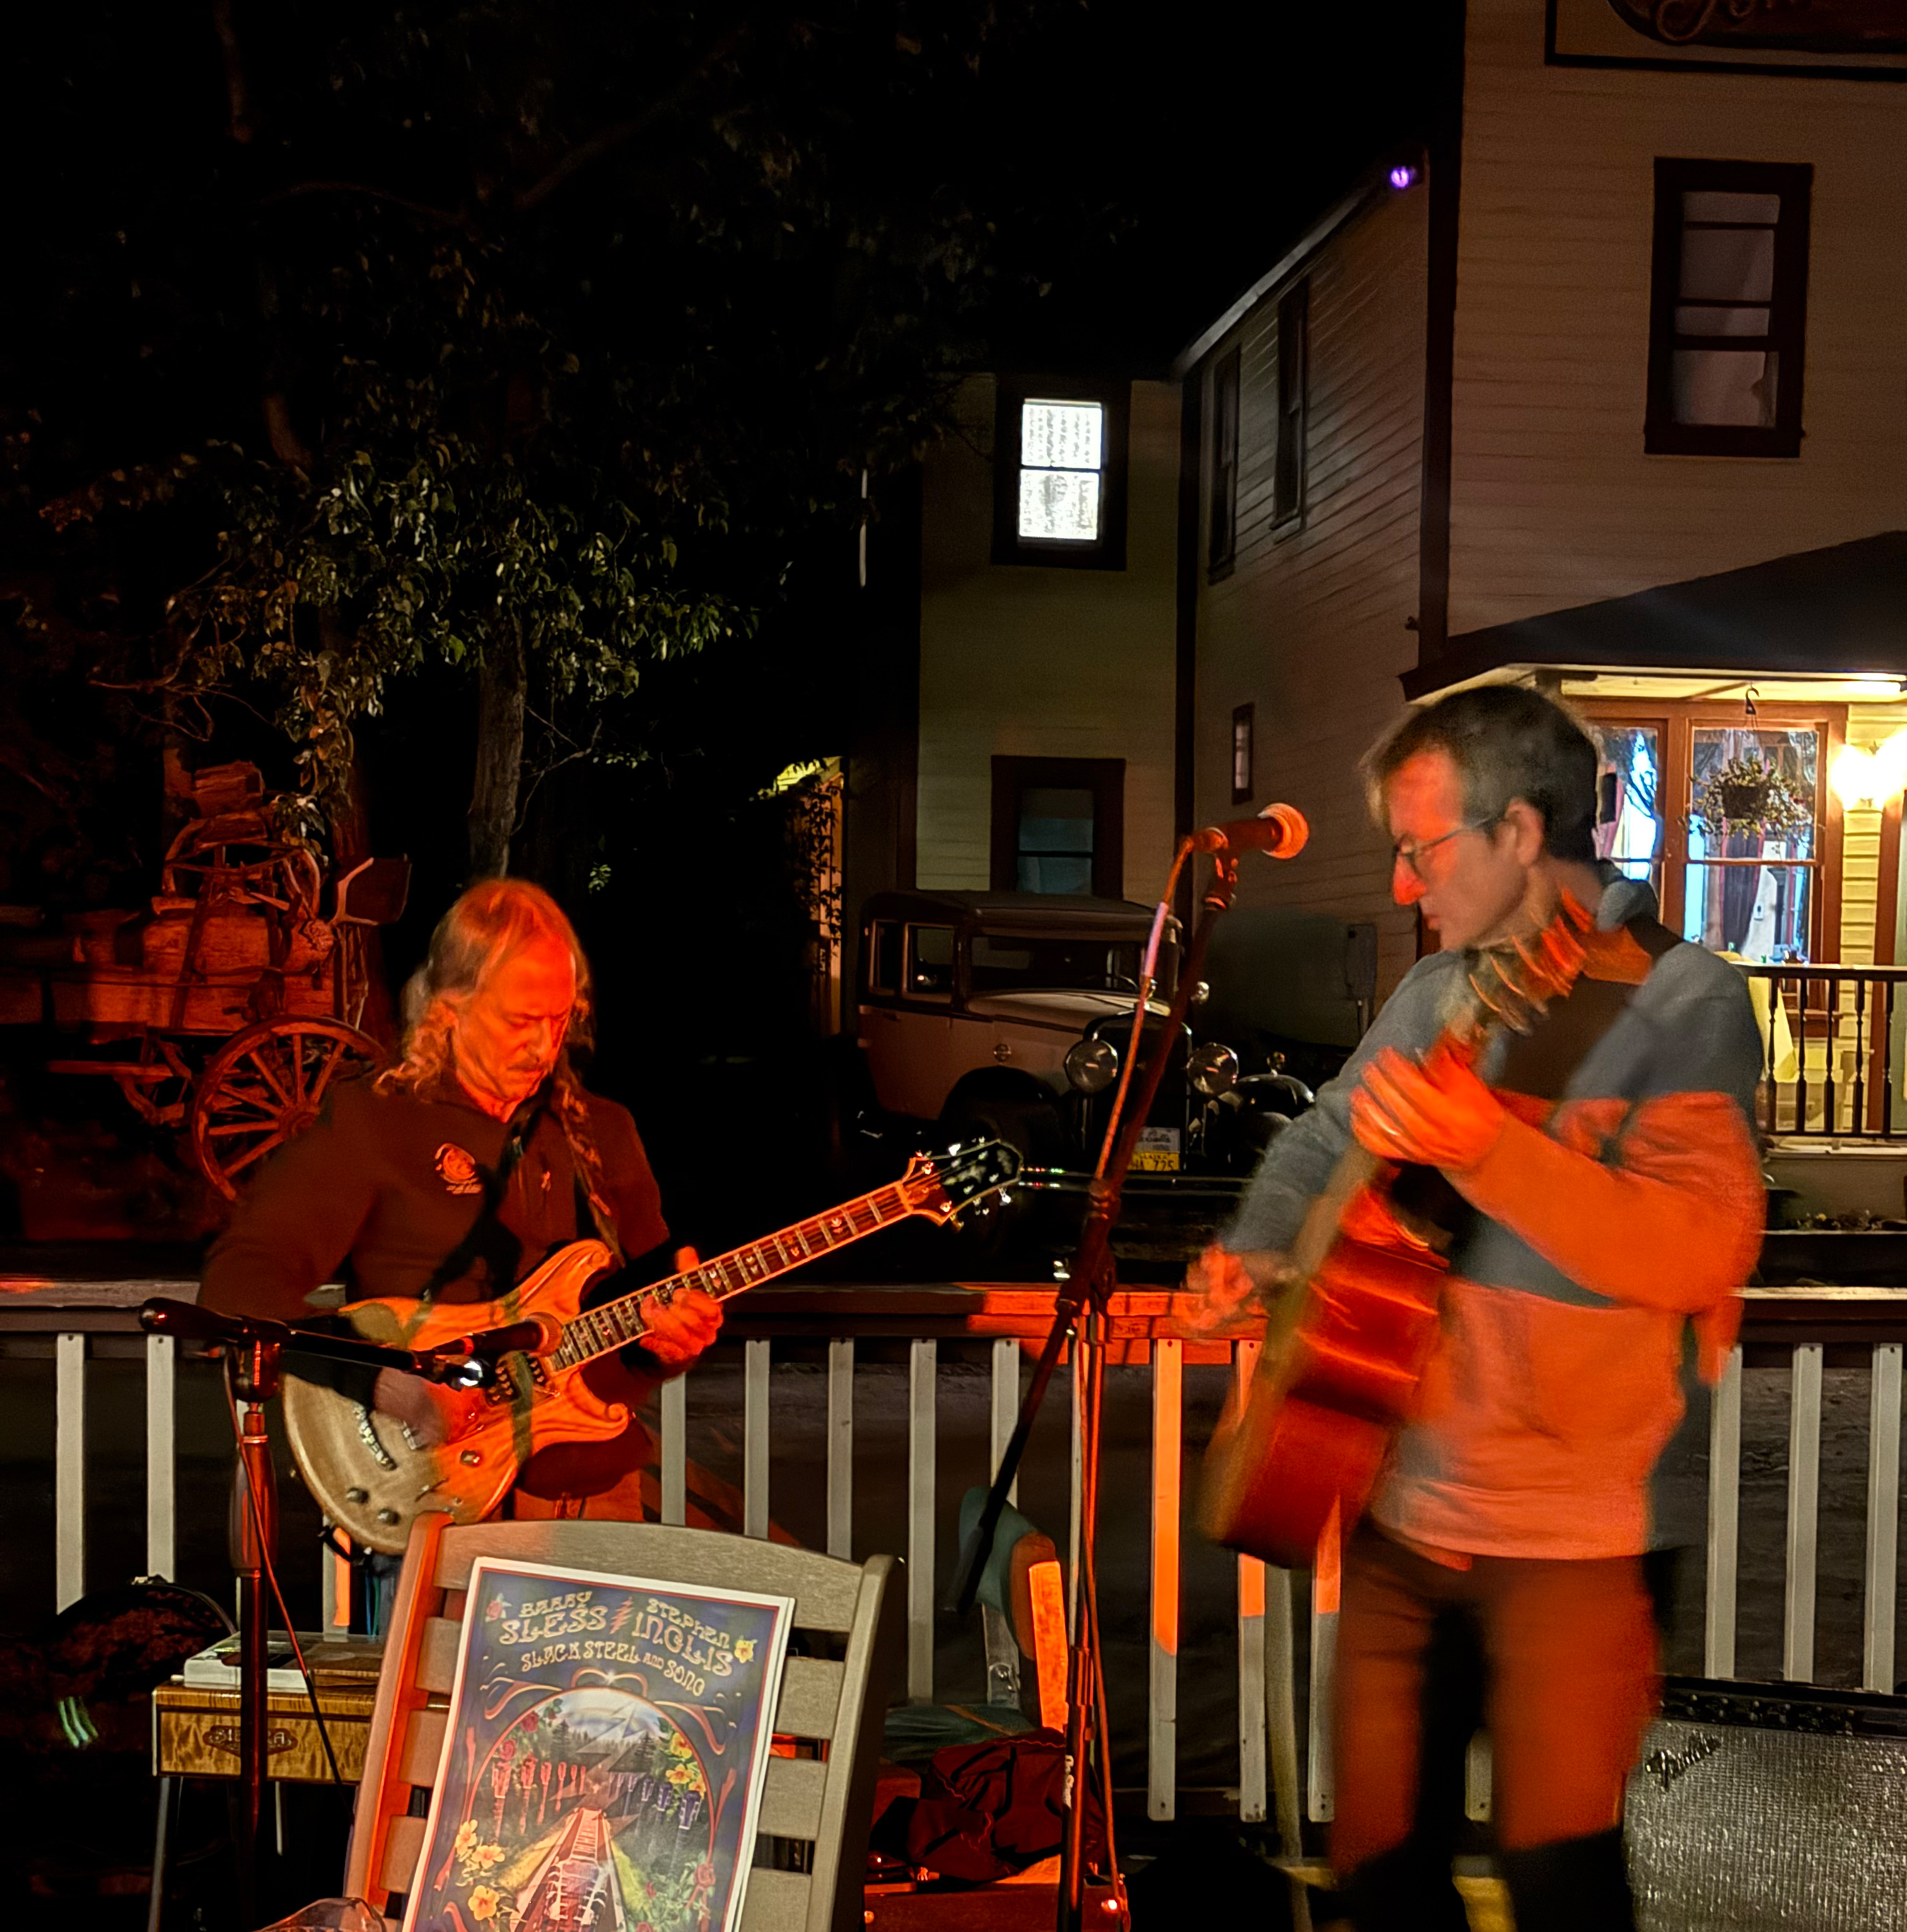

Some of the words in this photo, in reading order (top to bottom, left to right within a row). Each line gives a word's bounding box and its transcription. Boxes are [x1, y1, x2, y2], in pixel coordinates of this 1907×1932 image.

[518, 1591, 593, 1618] BARRY
[646, 1598, 730, 1649] STEPHEN
[499, 1606, 609, 1644] SLESS
[521, 1642, 581, 1672] SLACK
[583, 1641, 641, 1664] STEEL
[642, 1652, 665, 1670] AND
[631, 1612, 733, 1677] INGLIS
